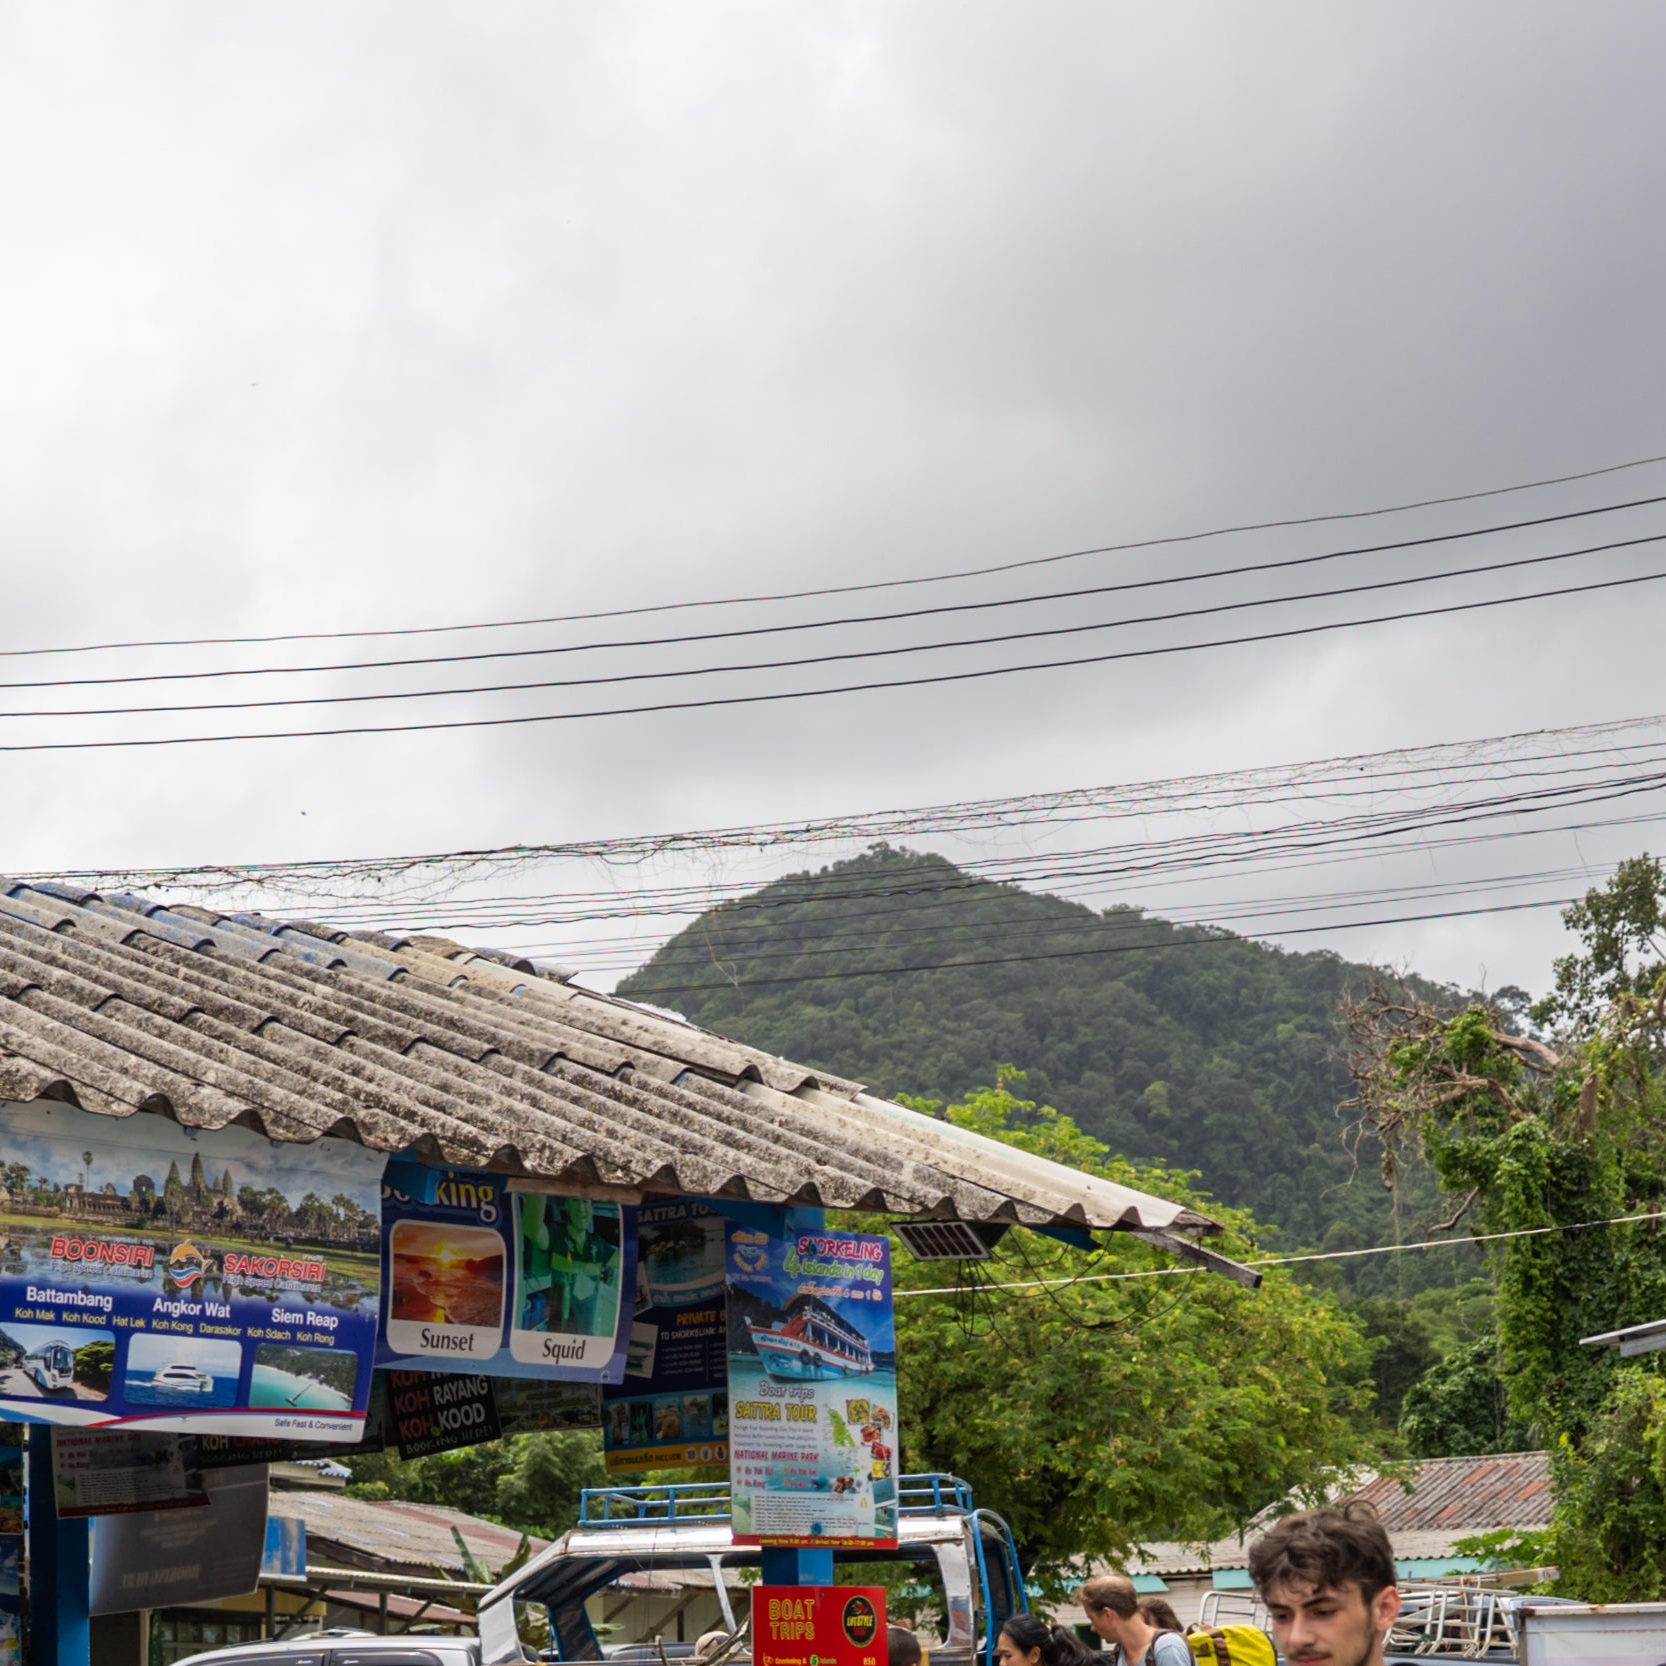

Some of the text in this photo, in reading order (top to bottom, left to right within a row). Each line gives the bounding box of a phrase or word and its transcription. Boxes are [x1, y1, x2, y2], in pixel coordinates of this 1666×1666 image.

[636, 1204, 687, 1224] SATTRA
[50, 1237, 155, 1267] BOONSIRI
[223, 1253, 327, 1281] SAKORSIRI
[783, 1245, 801, 1279] 4
[844, 1263, 855, 1279] in
[855, 1264, 862, 1281] 1
[863, 1263, 885, 1286] day
[26, 1286, 338, 1331] Battambang Angkor Wat Siem Reap
[676, 1310, 716, 1324] PRIVATE
[15, 1307, 33, 1319] Koh
[35, 1309, 55, 1321] Mak
[62, 1312, 80, 1322] Koh
[82, 1313, 106, 1325] Kood
[112, 1315, 127, 1327] Hat
[151, 1319, 169, 1330] Koh
[171, 1321, 193, 1334] Kong
[200, 1322, 241, 1336] Darasakor
[247, 1327, 263, 1338] Koh
[265, 1328, 291, 1340] Sdach
[296, 1331, 312, 1342] Koh
[314, 1333, 335, 1346] Rong
[420, 1328, 475, 1351] Sunset
[542, 1338, 587, 1365] Squid
[395, 1391, 430, 1415] KOH
[433, 1375, 489, 1406] RAYANG
[759, 1380, 815, 1402] Boat trips
[399, 1403, 486, 1440] KOH KOOD
[735, 1401, 818, 1423] SATTRA TOUR
[292, 1419, 307, 1428] Fast
[308, 1420, 313, 1429] &
[57, 1438, 92, 1447] NATIONAL
[202, 1436, 229, 1451] KOH
[405, 1434, 458, 1455] BOOKING
[734, 1450, 819, 1463] NATIONAL MARINE PARK
[768, 1598, 815, 1621] BOAT
[768, 1621, 815, 1640] TRIPS
[863, 1657, 876, 1666] 850
